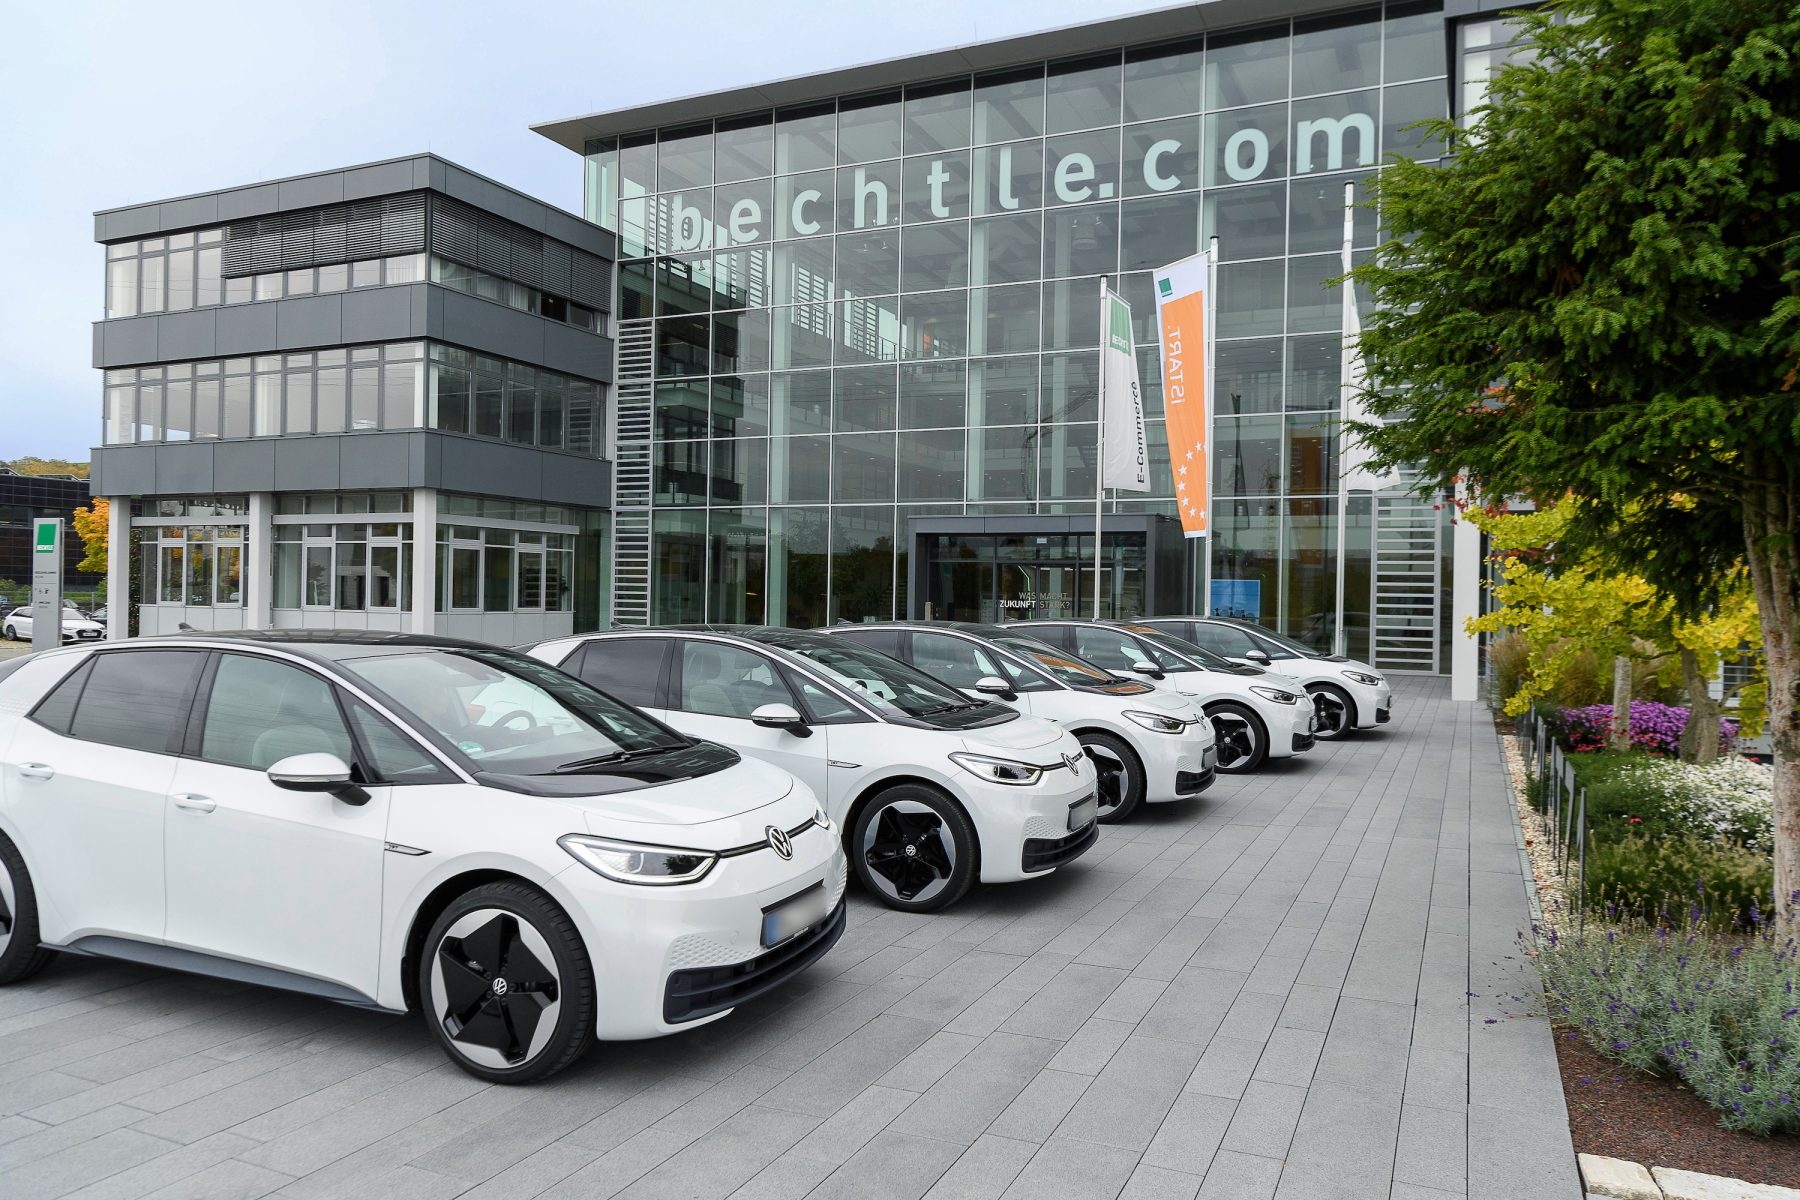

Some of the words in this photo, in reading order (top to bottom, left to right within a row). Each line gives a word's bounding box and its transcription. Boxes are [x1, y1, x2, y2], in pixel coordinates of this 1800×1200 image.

[672, 110, 1376, 252] bechtle.com
[1131, 381, 1145, 484] E-Commerce
[999, 600, 1037, 609] ZUKUNFT
[1039, 601, 1071, 609] STARK?
[1018, 592, 1037, 600] WAS
[1039, 592, 1068, 600] MACHT
